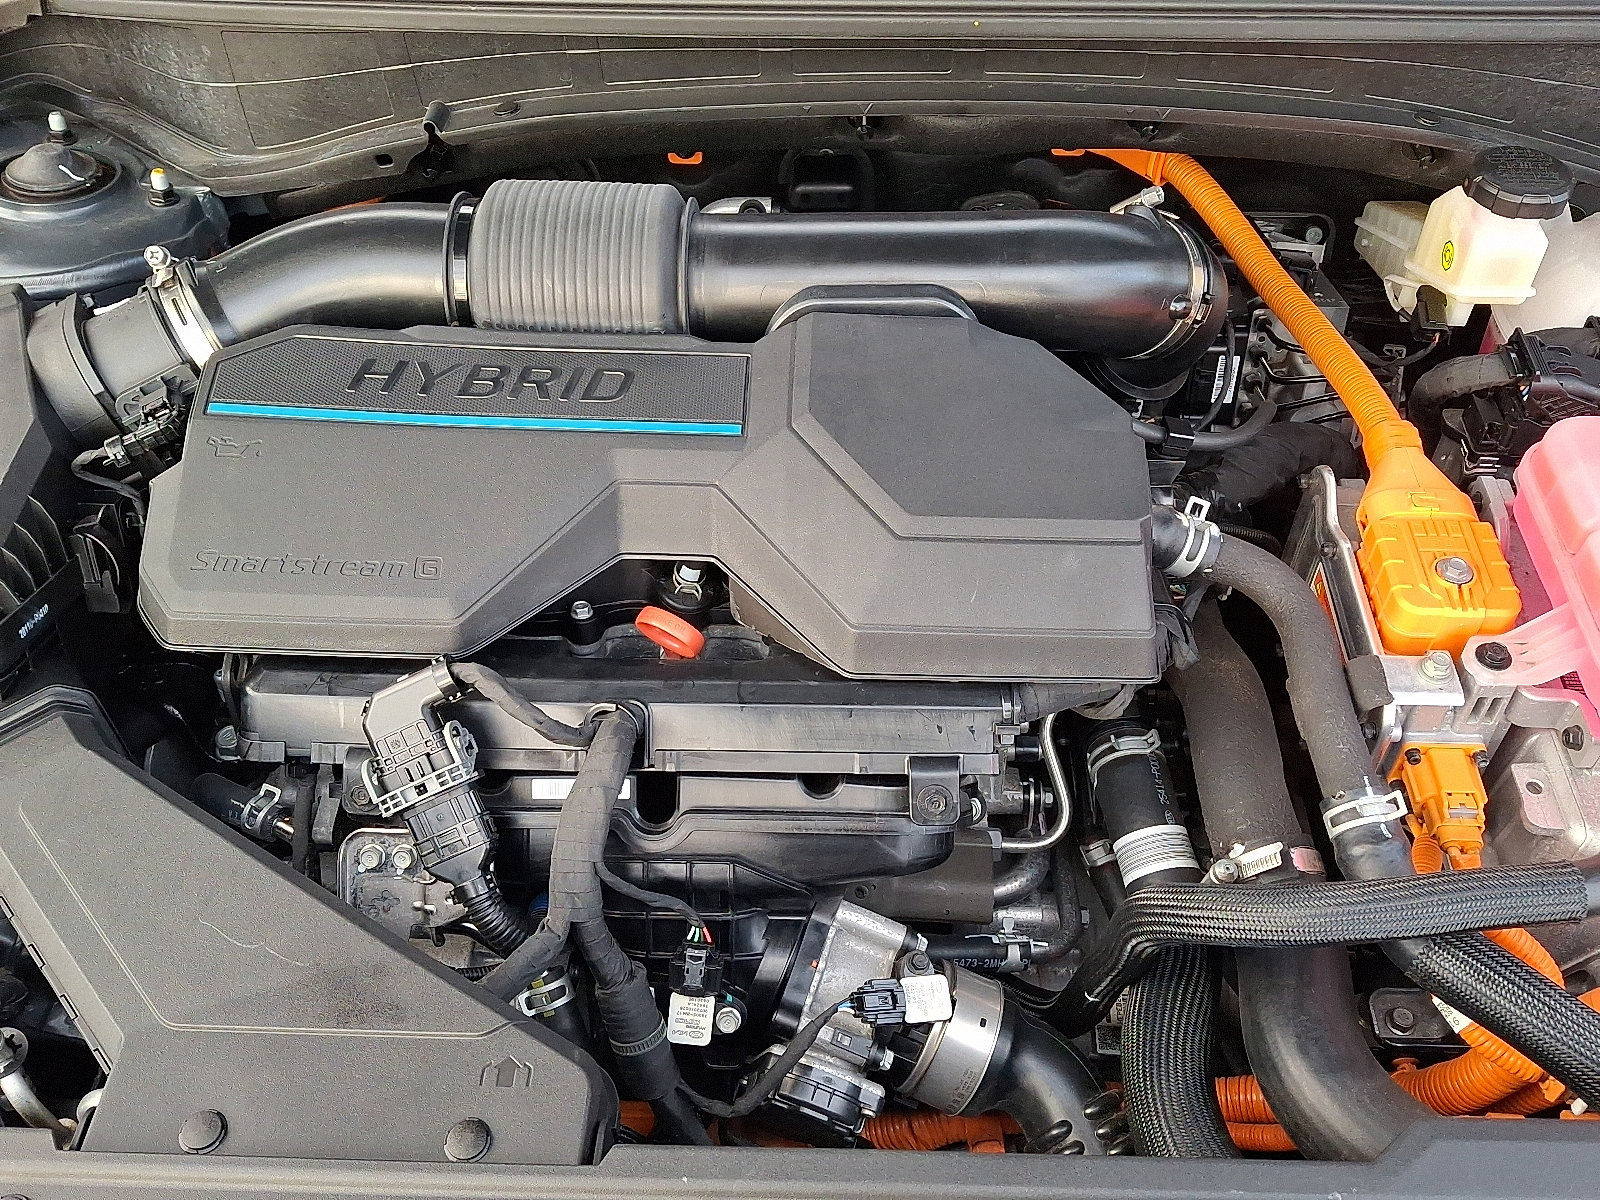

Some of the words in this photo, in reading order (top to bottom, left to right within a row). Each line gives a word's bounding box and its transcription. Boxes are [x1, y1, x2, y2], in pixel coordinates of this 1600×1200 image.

[346, 358, 634, 403] HYBRID
[190, 549, 408, 577] Smartstream
[417, 557, 442, 579] G
